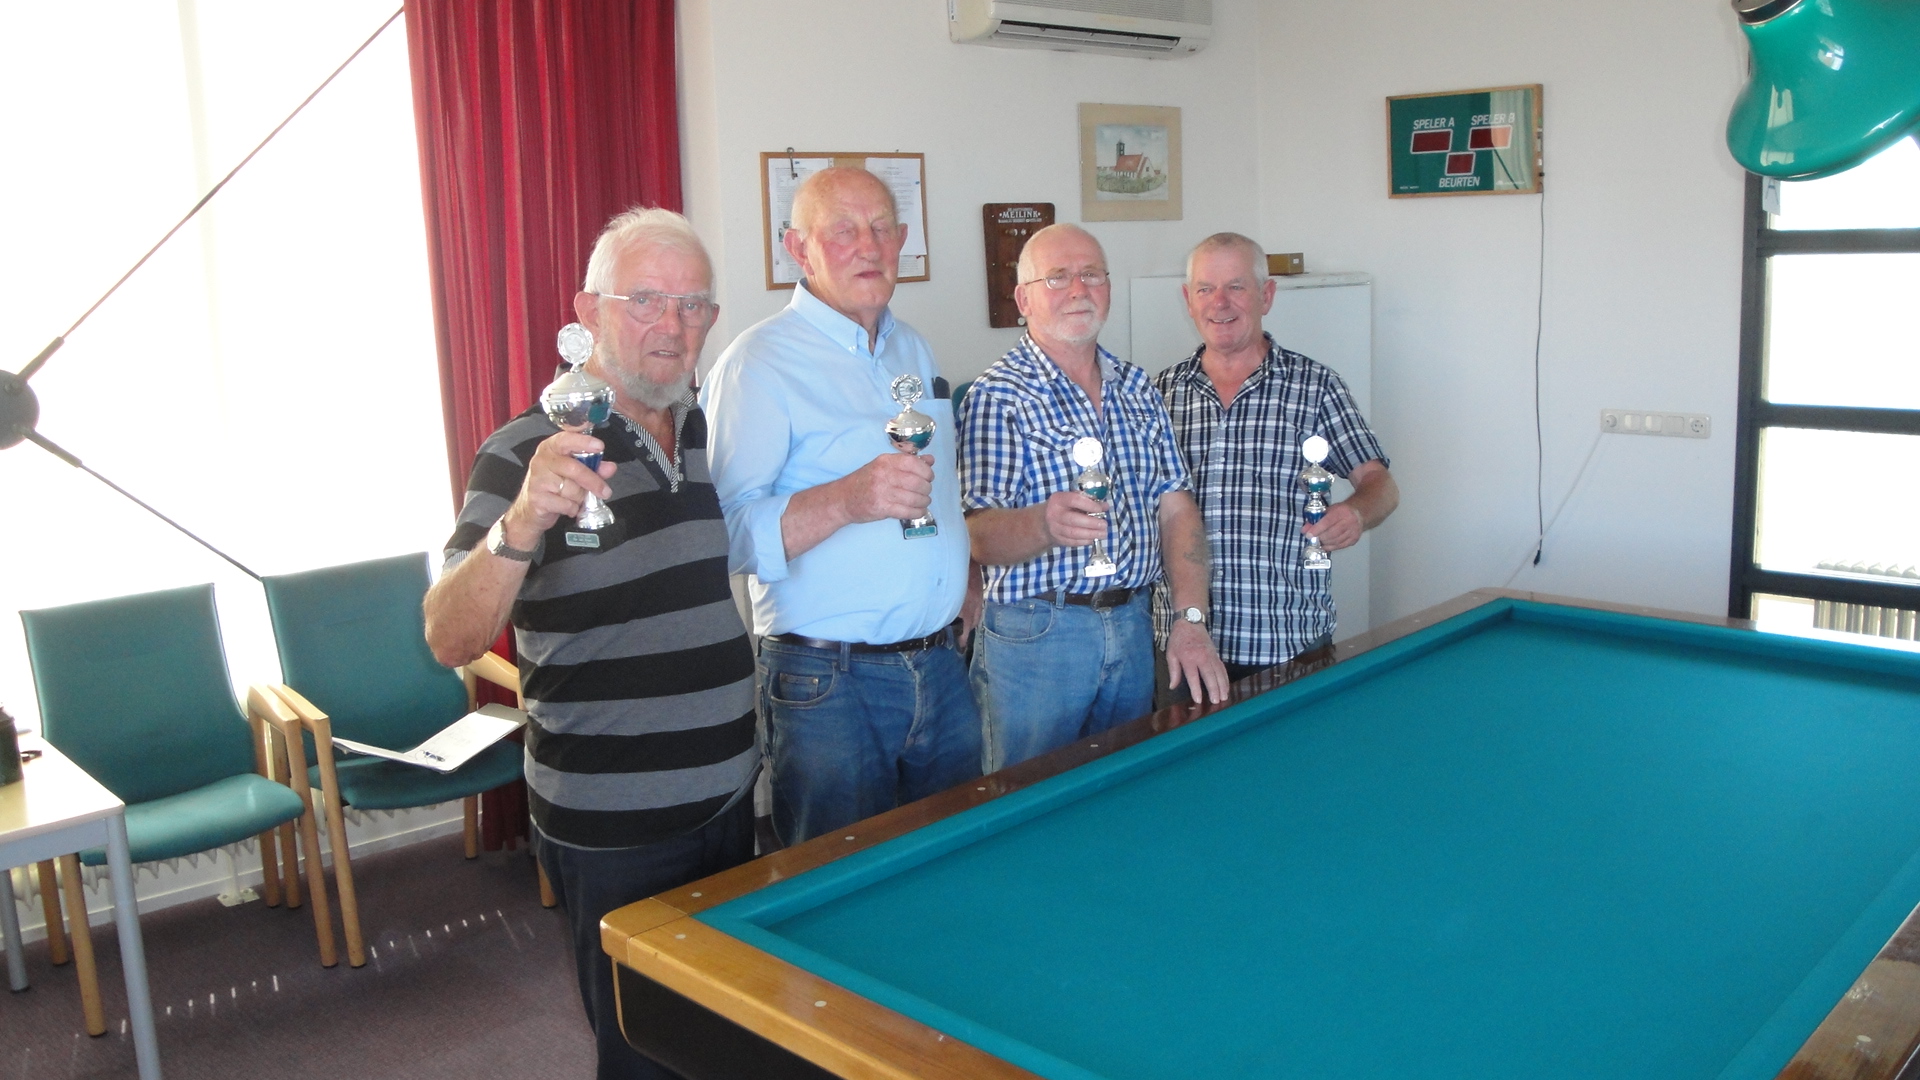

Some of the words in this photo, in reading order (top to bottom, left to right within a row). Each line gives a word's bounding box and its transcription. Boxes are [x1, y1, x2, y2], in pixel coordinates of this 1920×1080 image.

[1413, 118, 1446, 130] SPELER
[1448, 117, 1455, 127] A
[1471, 114, 1505, 126] SPELER
[1508, 113, 1516, 124] B
[1439, 176, 1480, 188] BEURTEN
[1002, 210, 1038, 219] MEILINK
